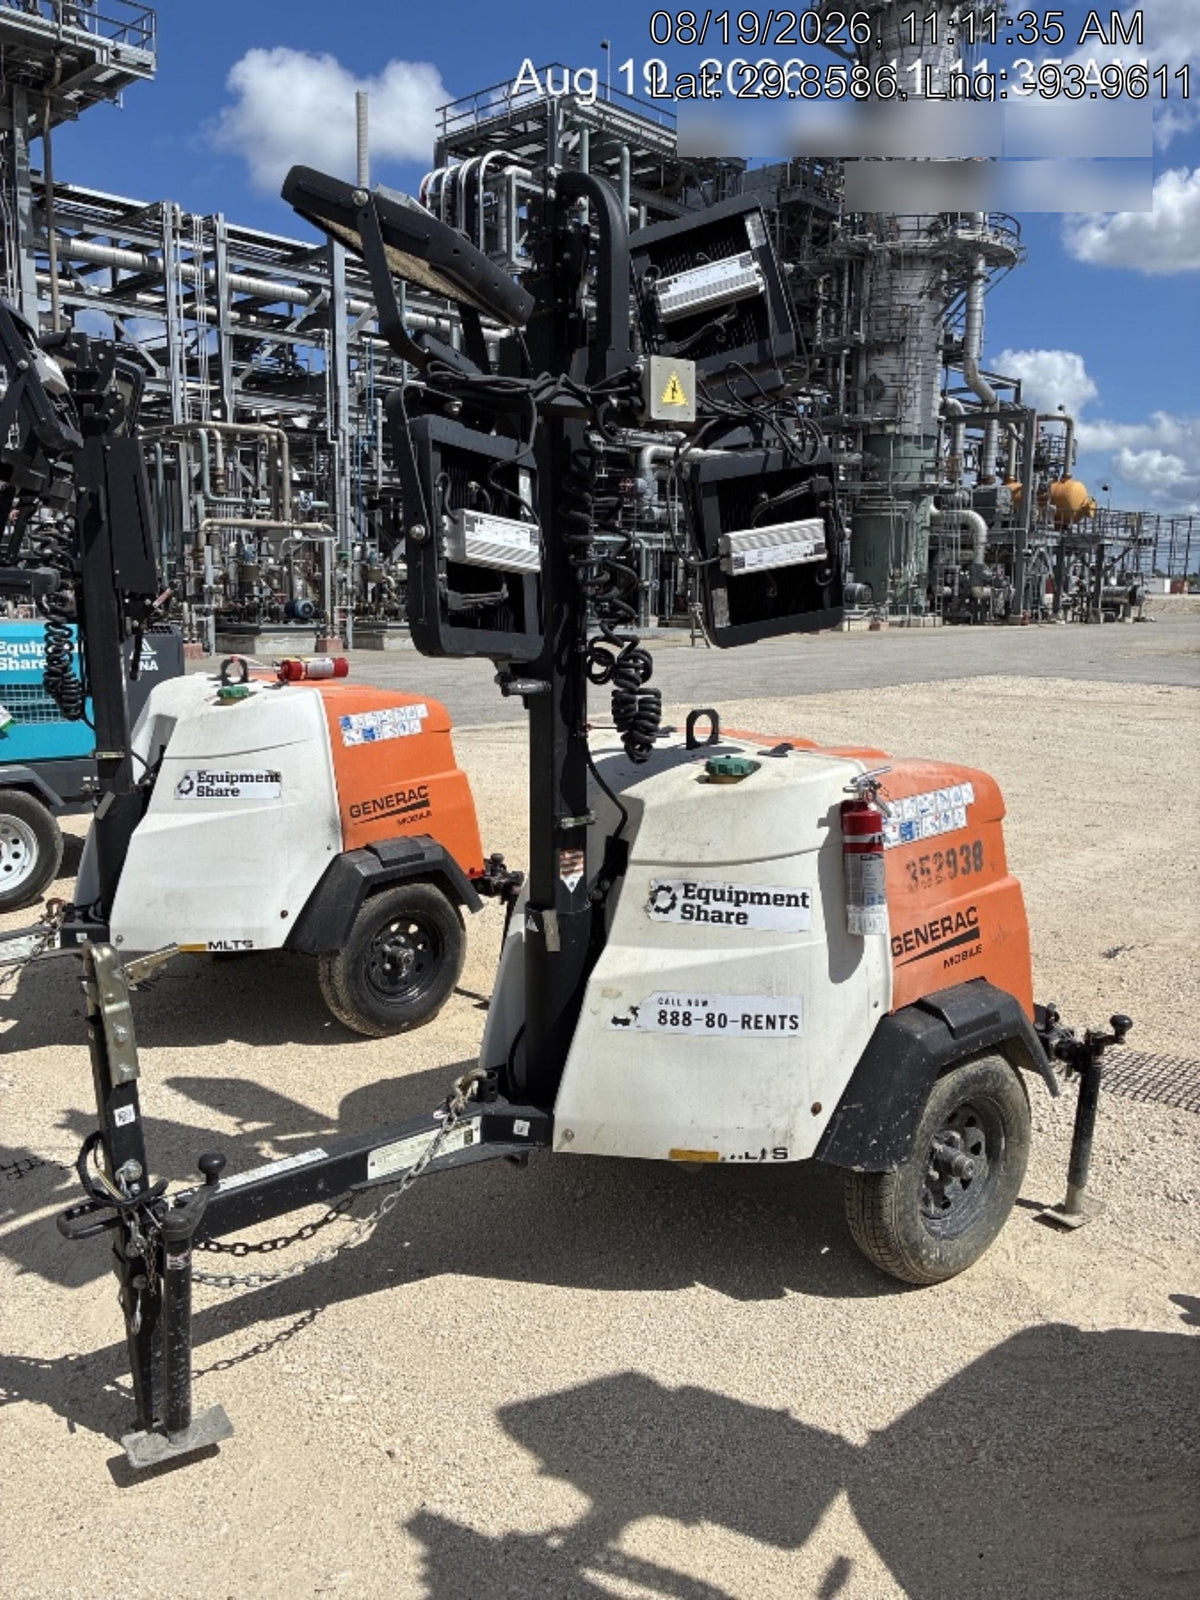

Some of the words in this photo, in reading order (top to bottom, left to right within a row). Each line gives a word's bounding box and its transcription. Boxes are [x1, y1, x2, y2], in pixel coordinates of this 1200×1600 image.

[197, 771, 281, 786] Equipment
[196, 786, 240, 797] Share
[349, 785, 428, 818] GENERAC
[683, 883, 810, 908] Equipment
[680, 903, 749, 925] Share
[890, 906, 979, 957] GENERAC
[943, 943, 983, 969] MOBILE
[657, 997, 682, 1007] CALL
[657, 1009, 800, 1030] 888-80-RENTS
